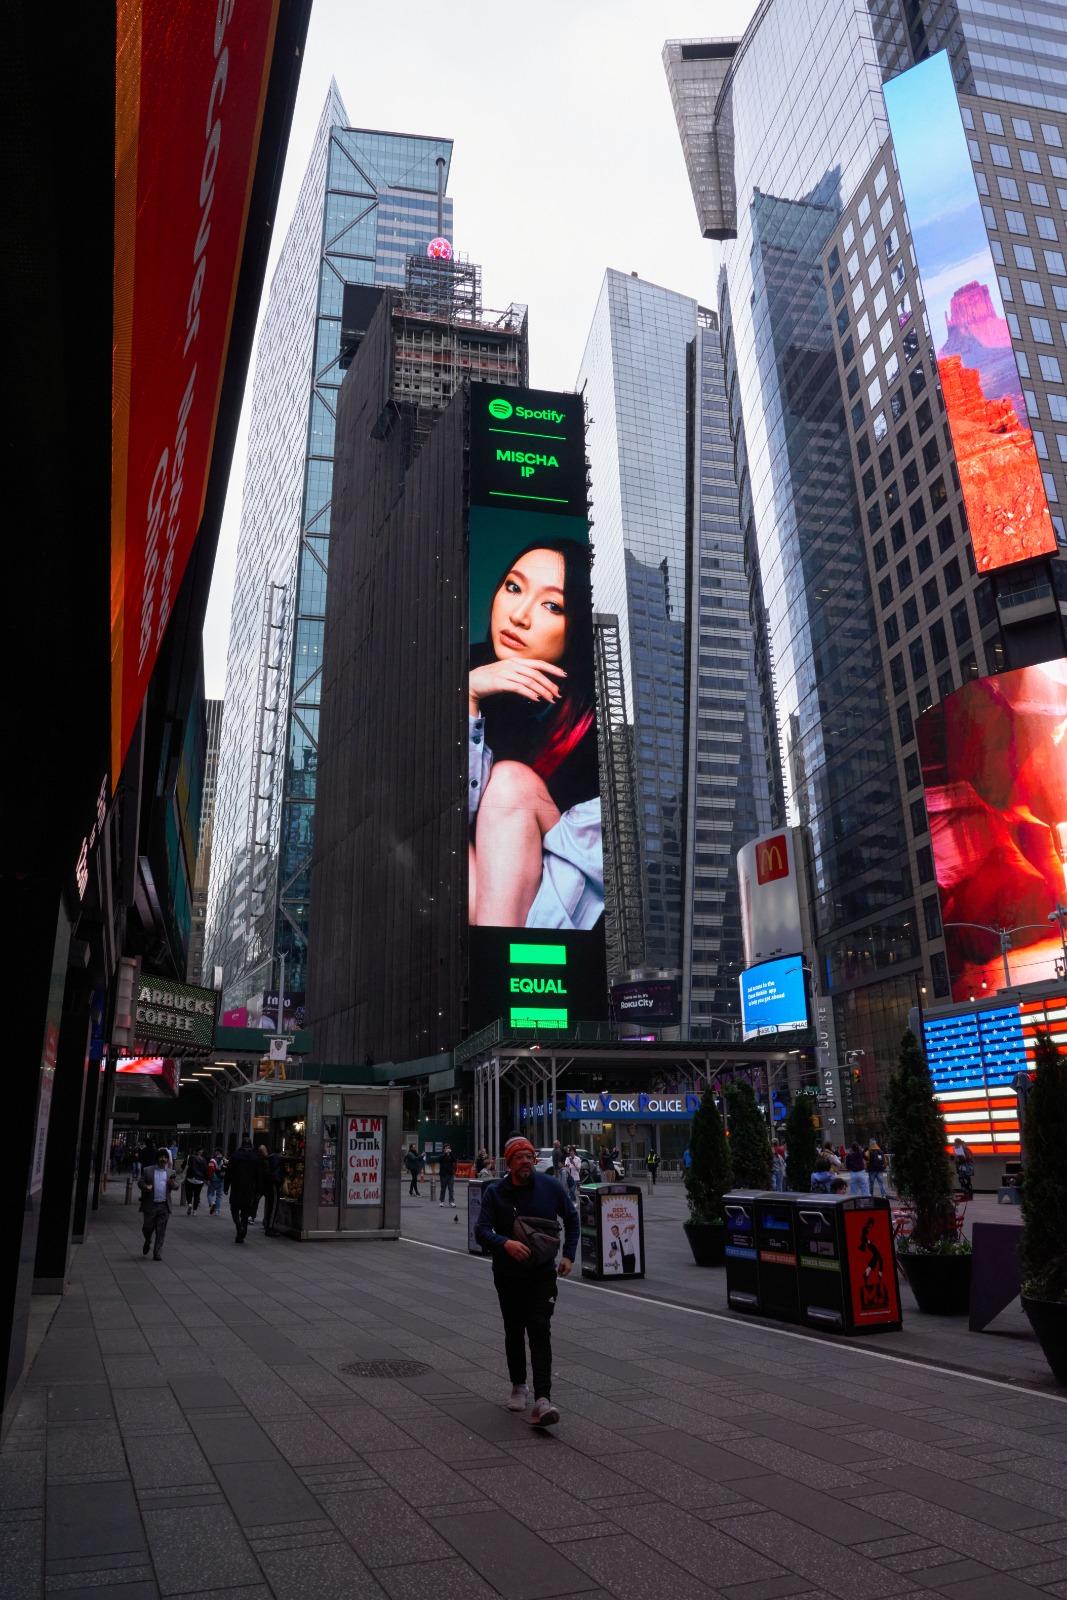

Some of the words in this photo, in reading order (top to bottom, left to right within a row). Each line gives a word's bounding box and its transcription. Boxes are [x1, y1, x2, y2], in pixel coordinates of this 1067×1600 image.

[516, 407, 565, 424] Spotify
[496, 449, 560, 468] MISCHA
[521, 466, 535, 478] IP
[137, 446, 169, 677] Chicken
[510, 978, 568, 994] EQUAL
[638, 999, 654, 1008] City
[136, 1005, 194, 1031] COFFEE
[566, 1092, 598, 1112] NEW
[599, 1094, 635, 1112] YORK
[640, 1093, 682, 1112] POLICE
[349, 1119, 381, 1132] ATM
[349, 1138, 380, 1151] Drink
[349, 1155, 379, 1170] Candy
[353, 1172, 377, 1183] ATM
